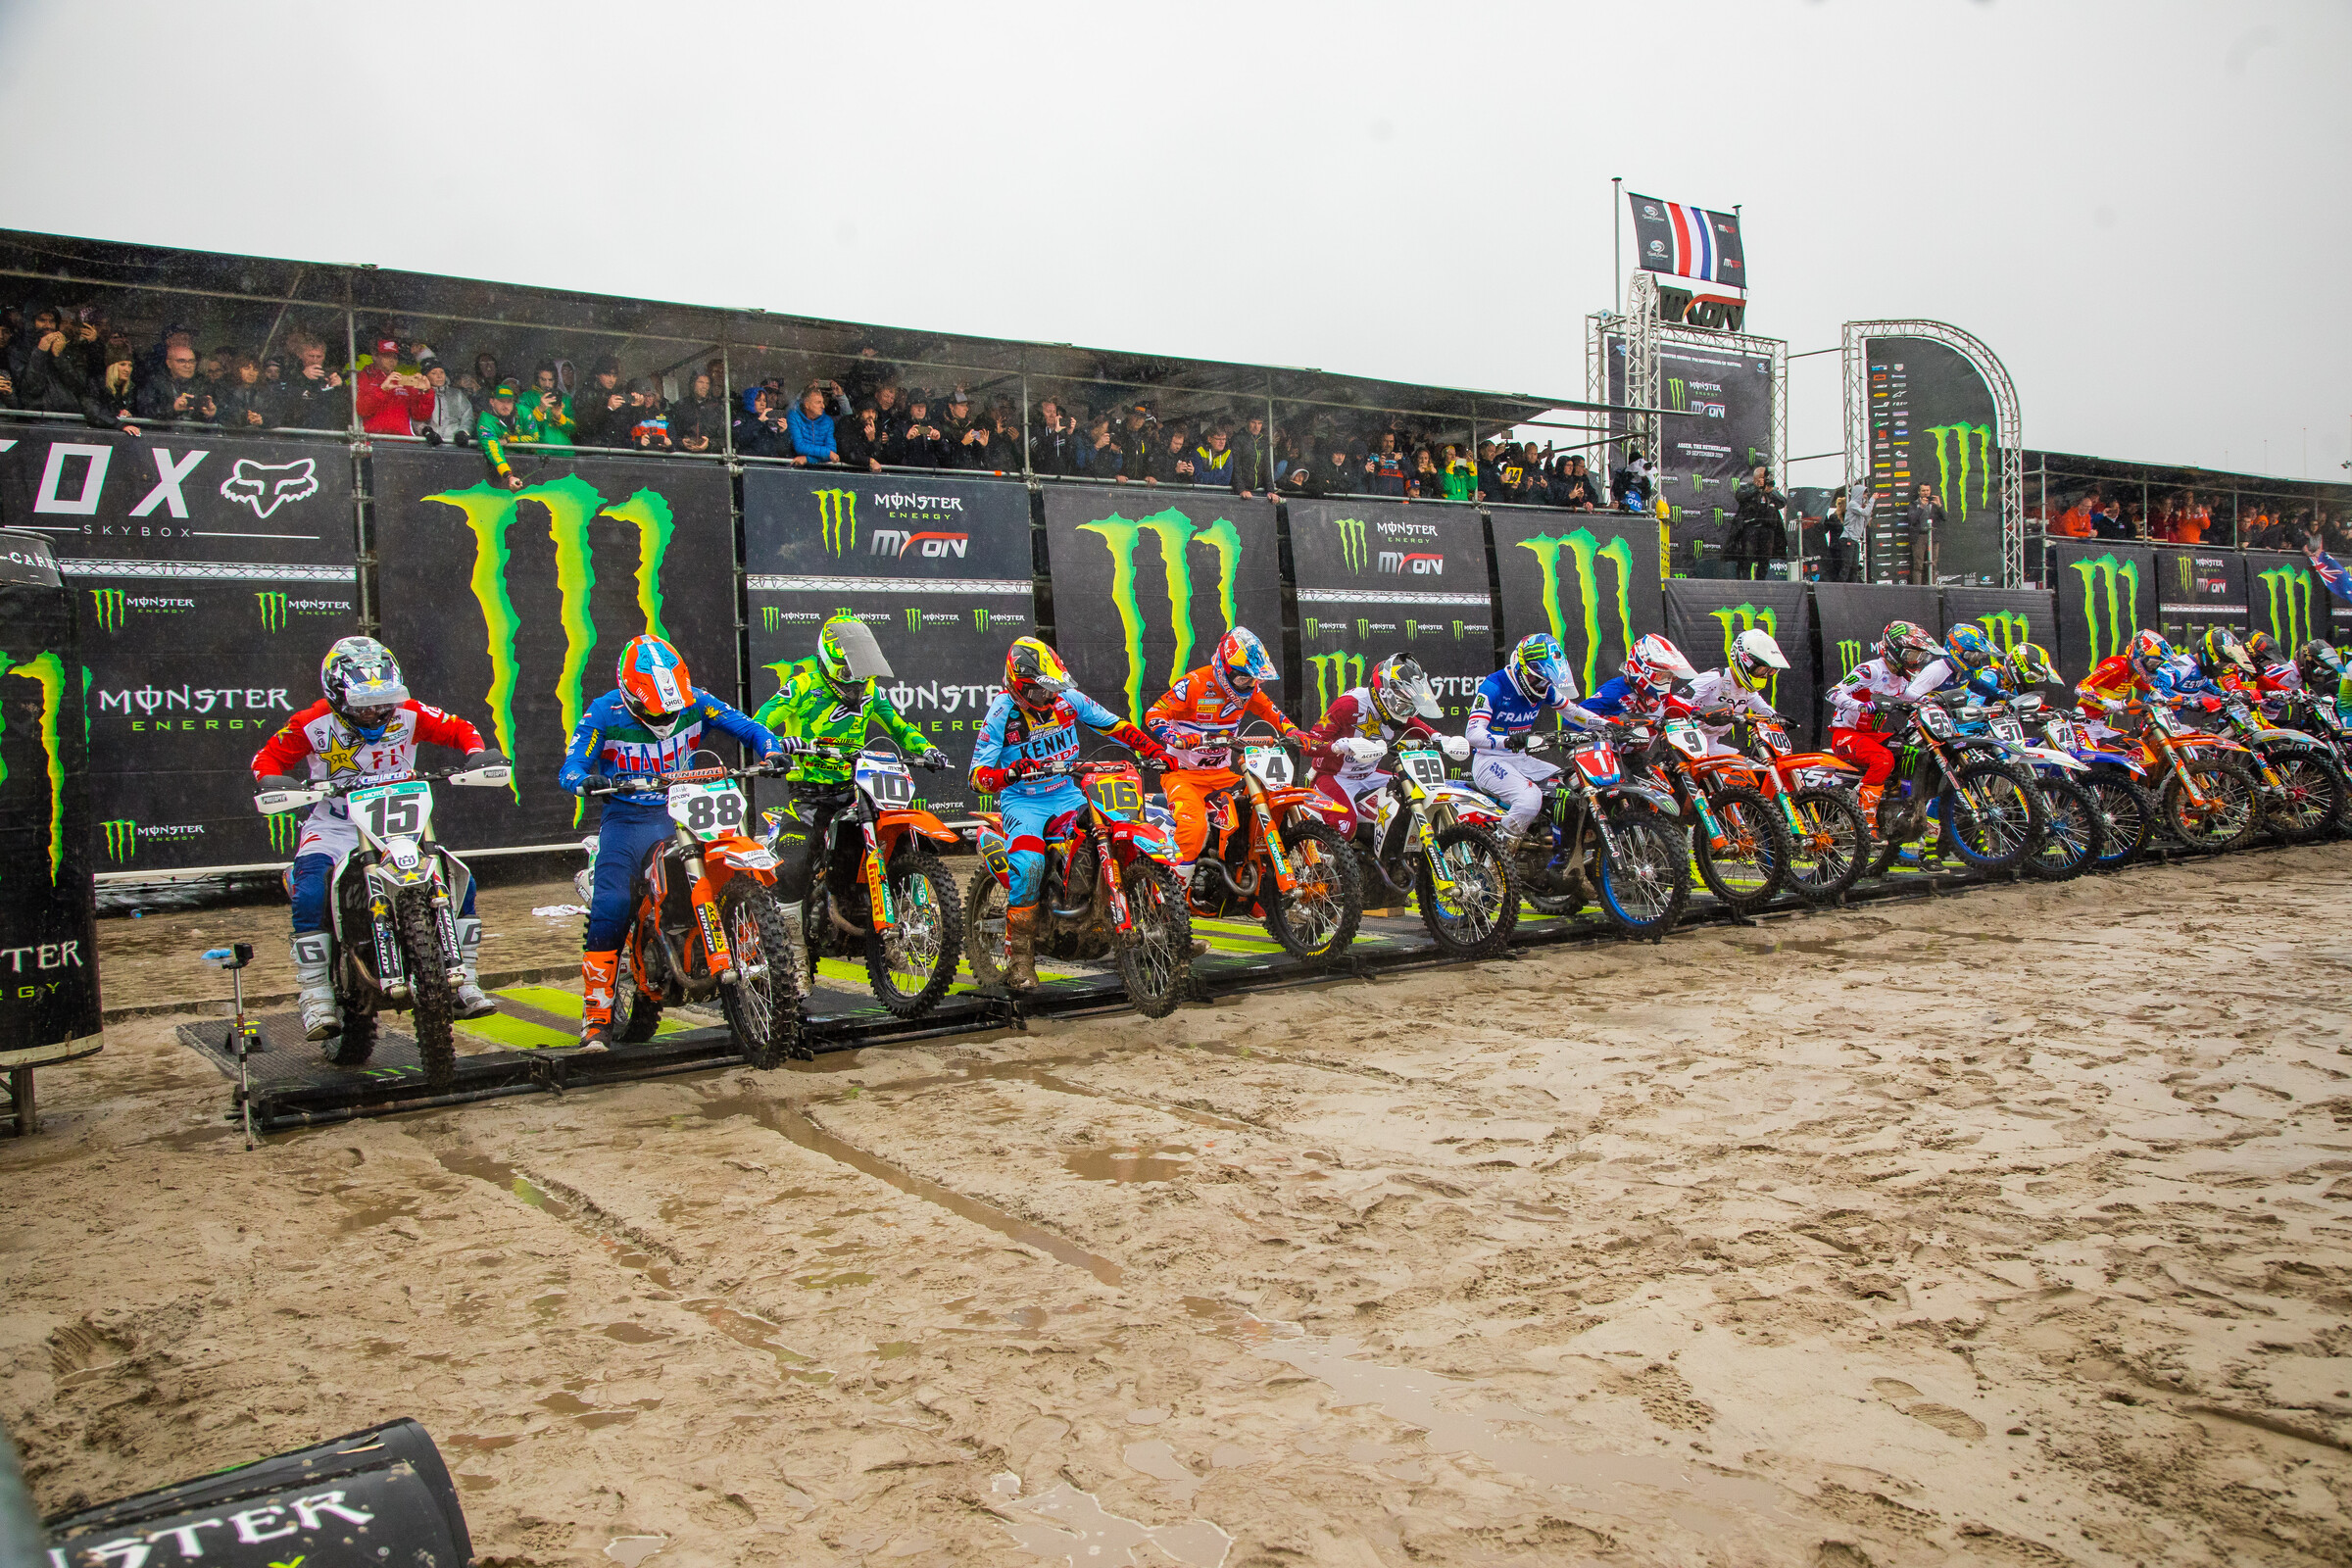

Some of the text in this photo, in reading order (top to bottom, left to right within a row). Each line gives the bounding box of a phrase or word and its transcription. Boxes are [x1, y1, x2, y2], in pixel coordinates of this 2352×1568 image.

[1690, 381, 1722, 392] MONSTER
[0, 439, 210, 518] OX
[875, 492, 963, 512] MONSTER
[889, 512, 951, 520] ENERGY
[83, 524, 190, 538] SKYBOX
[1377, 521, 1438, 536] MONSTER
[2195, 558, 2224, 567] MONSTER
[126, 596, 195, 609] MONSTER
[288, 599, 351, 611] MONSTER
[780, 612, 821, 620] MONSTER
[854, 612, 891, 621] MONSTER
[922, 612, 959, 621] MONSTER
[98, 684, 294, 714] MONSTER
[132, 719, 267, 731] ENERGY
[1496, 709, 1541, 723] FRANC
[1019, 727, 1074, 760] KENNY
[1683, 731, 1703, 753] 9
[1265, 757, 1287, 782] 4
[1413, 759, 1446, 785] 99
[869, 772, 910, 802] 10
[1096, 779, 1140, 811] 16
[365, 794, 420, 836] 15
[688, 794, 743, 830] 88
[137, 824, 205, 836] MONSTER
[1271, 842, 1286, 874] MOTOREX
[1428, 847, 1446, 881] DUNLOP
[868, 863, 884, 916] PIRELLI
[697, 906, 715, 953] DUNLOP
